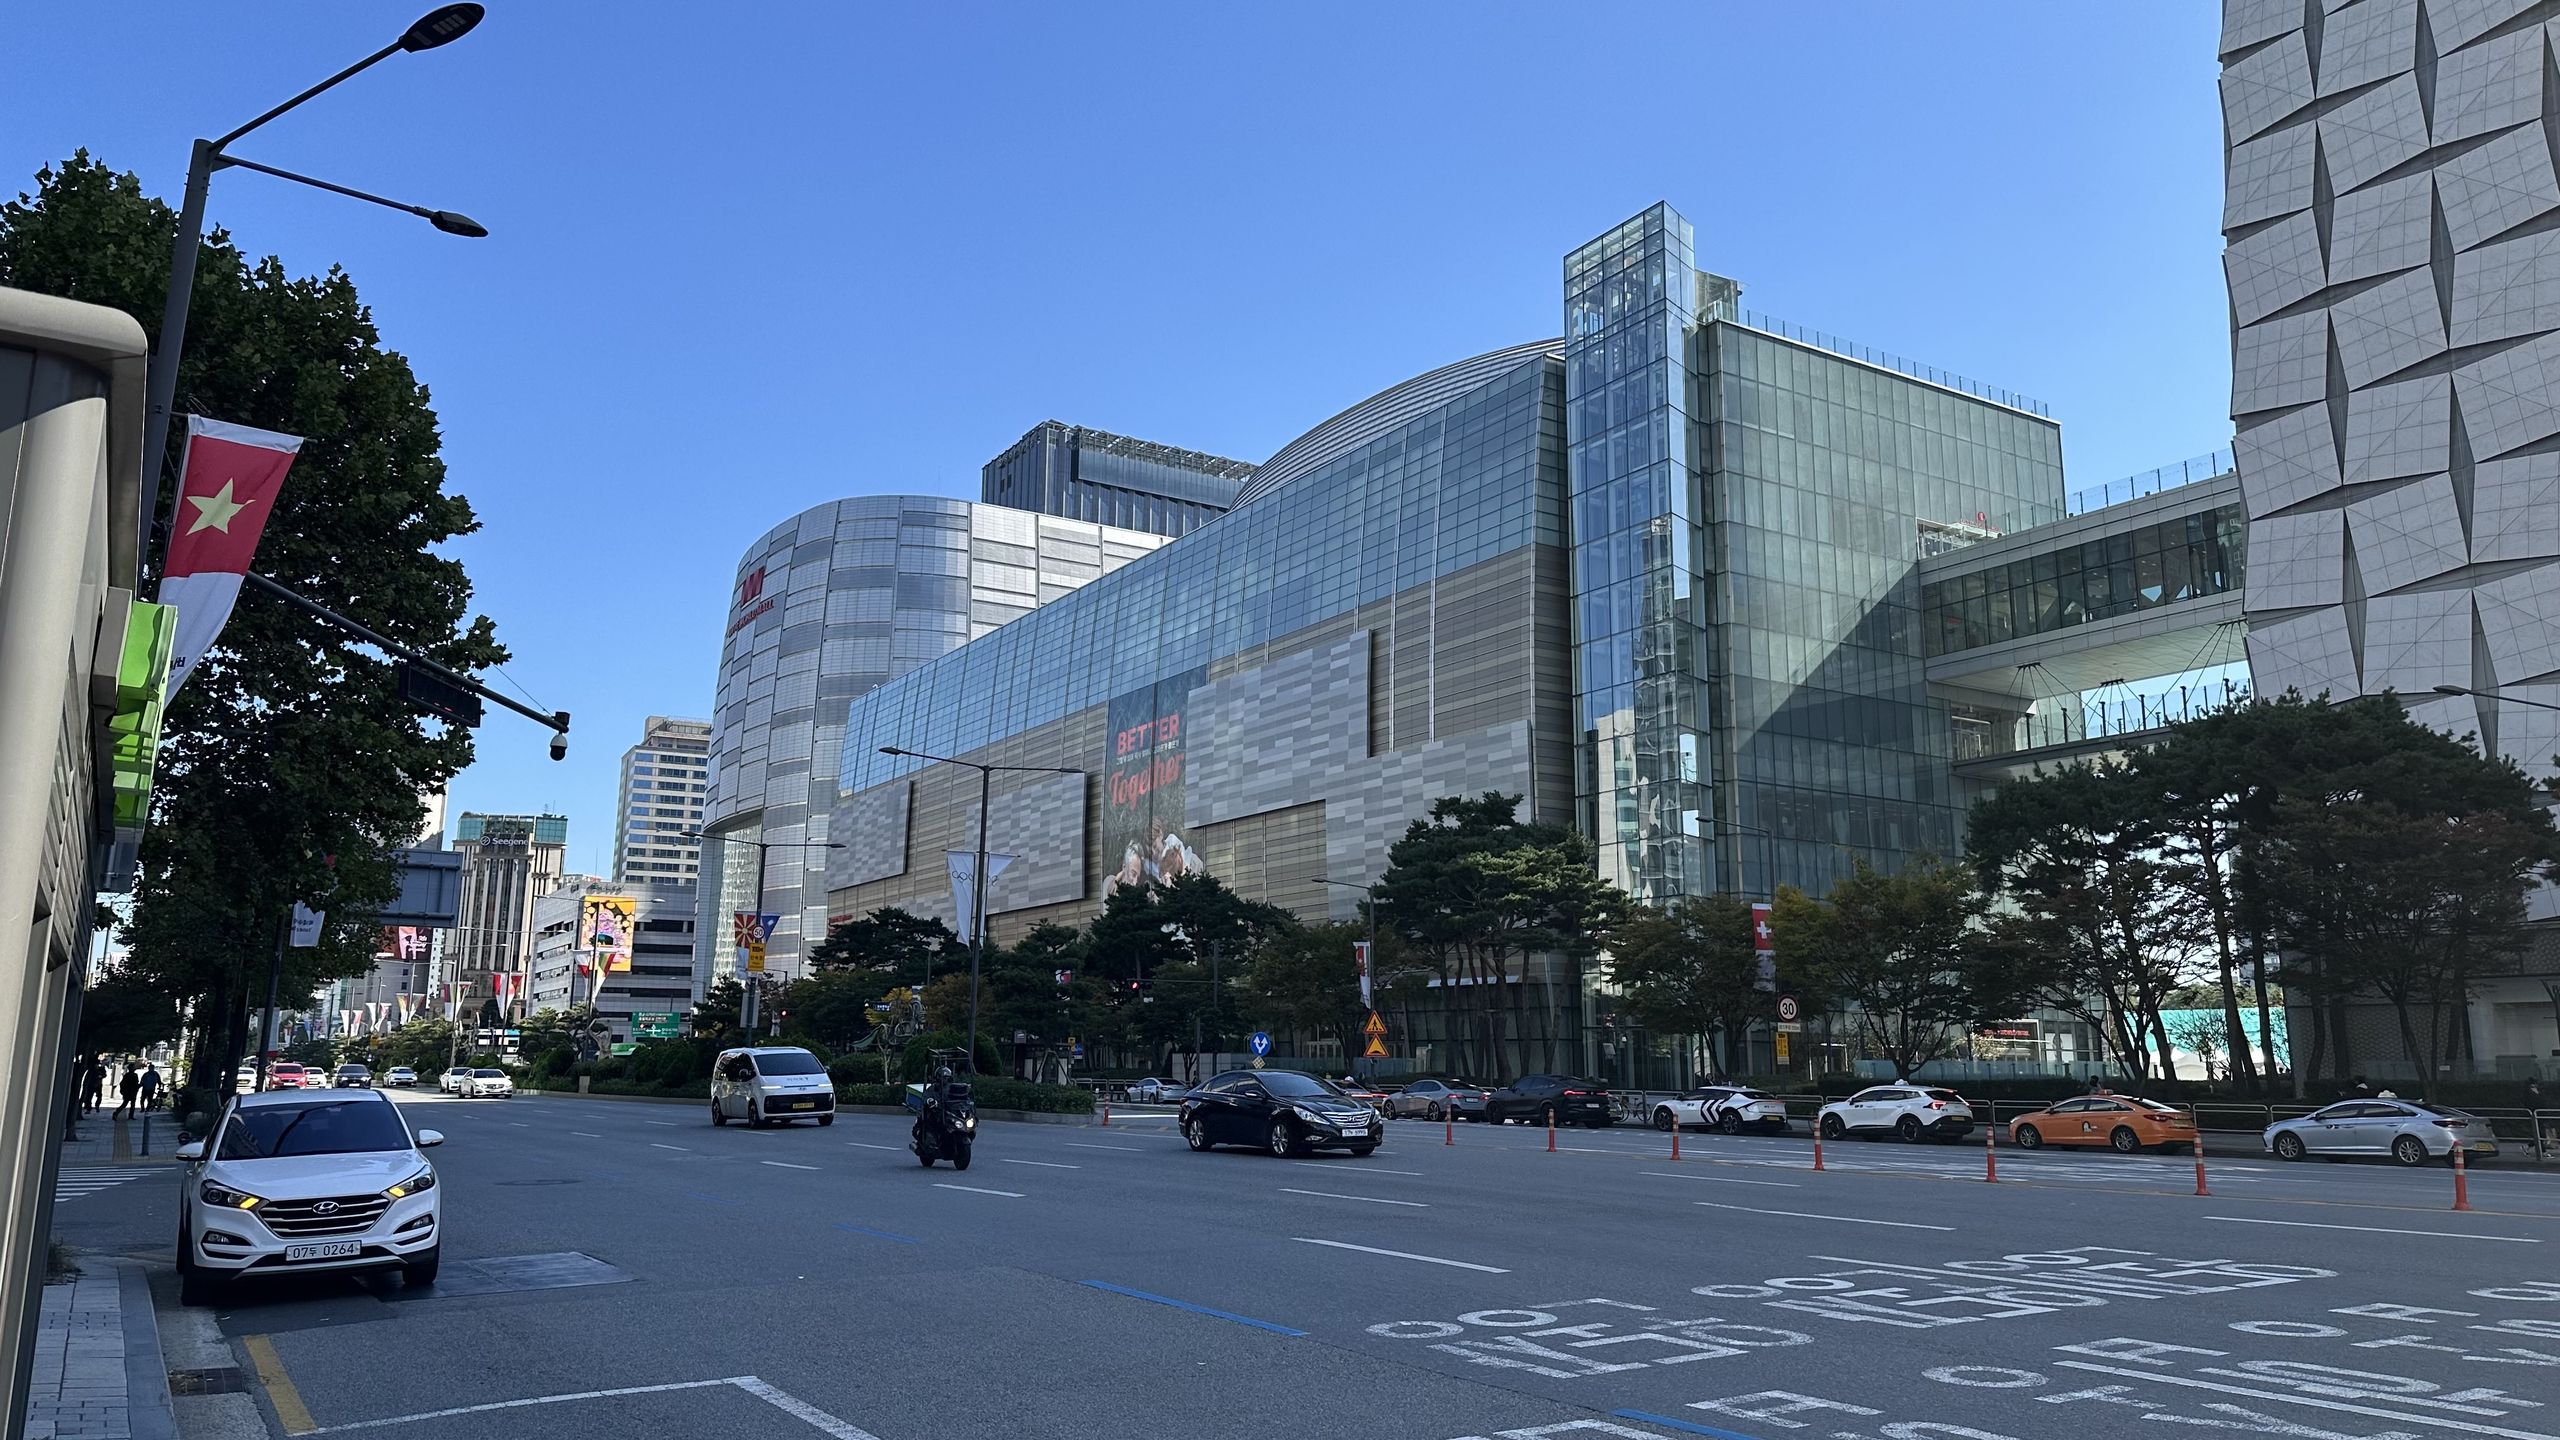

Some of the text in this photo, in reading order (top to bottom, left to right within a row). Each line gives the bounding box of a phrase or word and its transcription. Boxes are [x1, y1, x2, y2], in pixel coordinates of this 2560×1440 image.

[1118, 714, 1179, 755] BETTER
[1109, 752, 1185, 811] Together
[754, 929, 764, 937] 50
[1782, 1002, 1795, 1016] 30
[293, 1244, 354, 1258] 07두 0264
